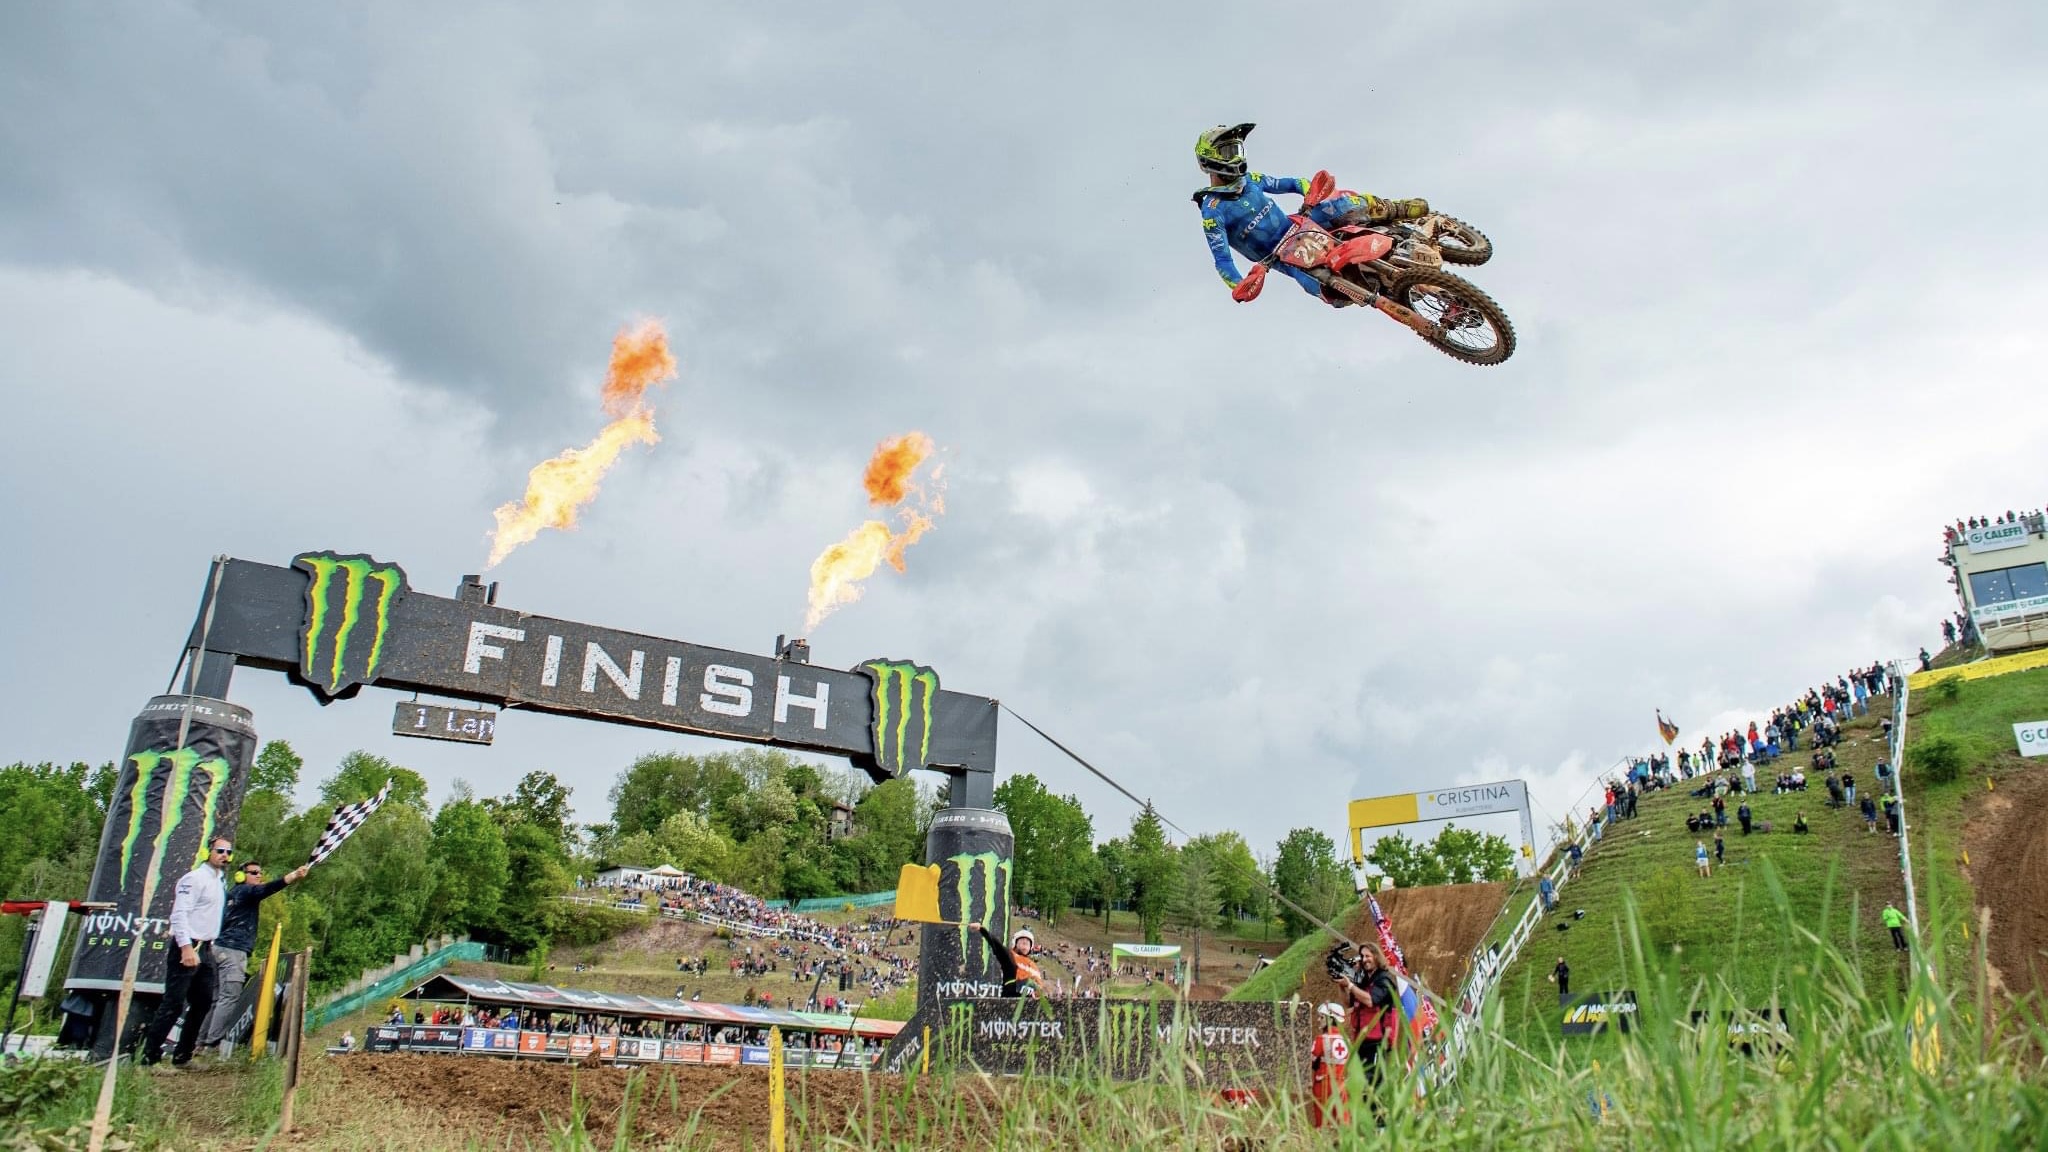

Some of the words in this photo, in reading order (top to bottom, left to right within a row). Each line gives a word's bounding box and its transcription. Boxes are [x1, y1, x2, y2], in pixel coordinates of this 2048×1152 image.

[1984, 526, 2022, 540] CALEFFI
[463, 620, 830, 730] FINISH
[1437, 786, 1510, 806] CRISTINA
[980, 1018, 1064, 1040] MONSTER
[1156, 1022, 1260, 1048] MNSTER
